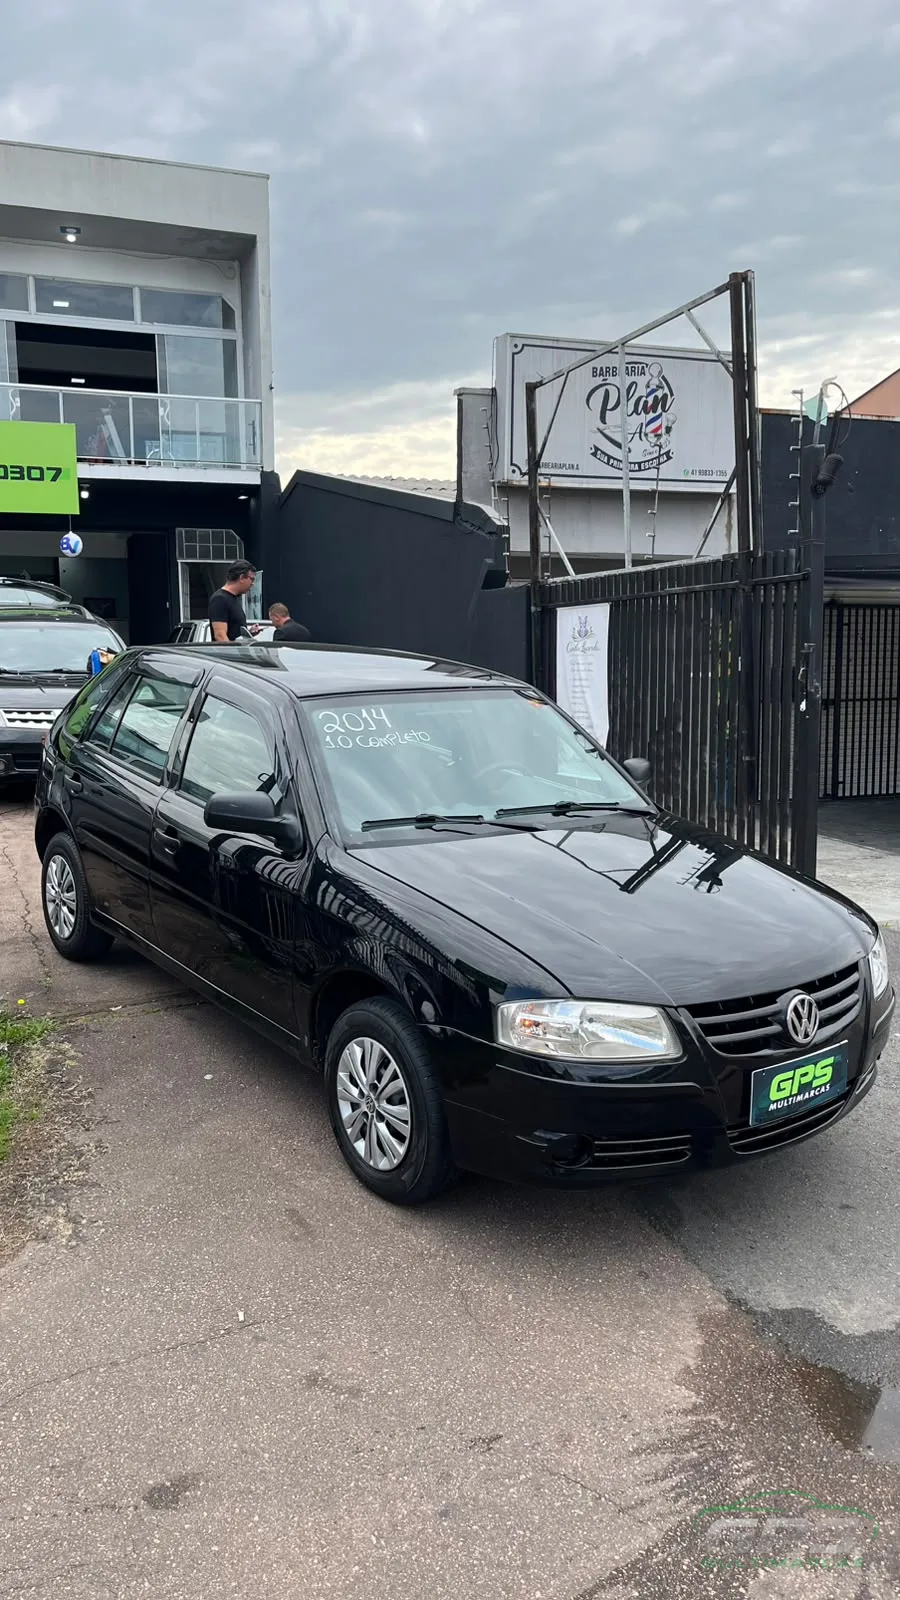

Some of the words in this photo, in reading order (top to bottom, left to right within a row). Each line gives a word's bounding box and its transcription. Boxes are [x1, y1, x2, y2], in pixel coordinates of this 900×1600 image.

[592, 366, 646, 378] BARBARIA
[586, 381, 676, 425] Plan
[596, 451, 608, 464] SUA
[318, 708, 391, 733] 2014
[769, 1057, 835, 1101] GPS
[768, 1083, 831, 1112] MULTIMARCAS
